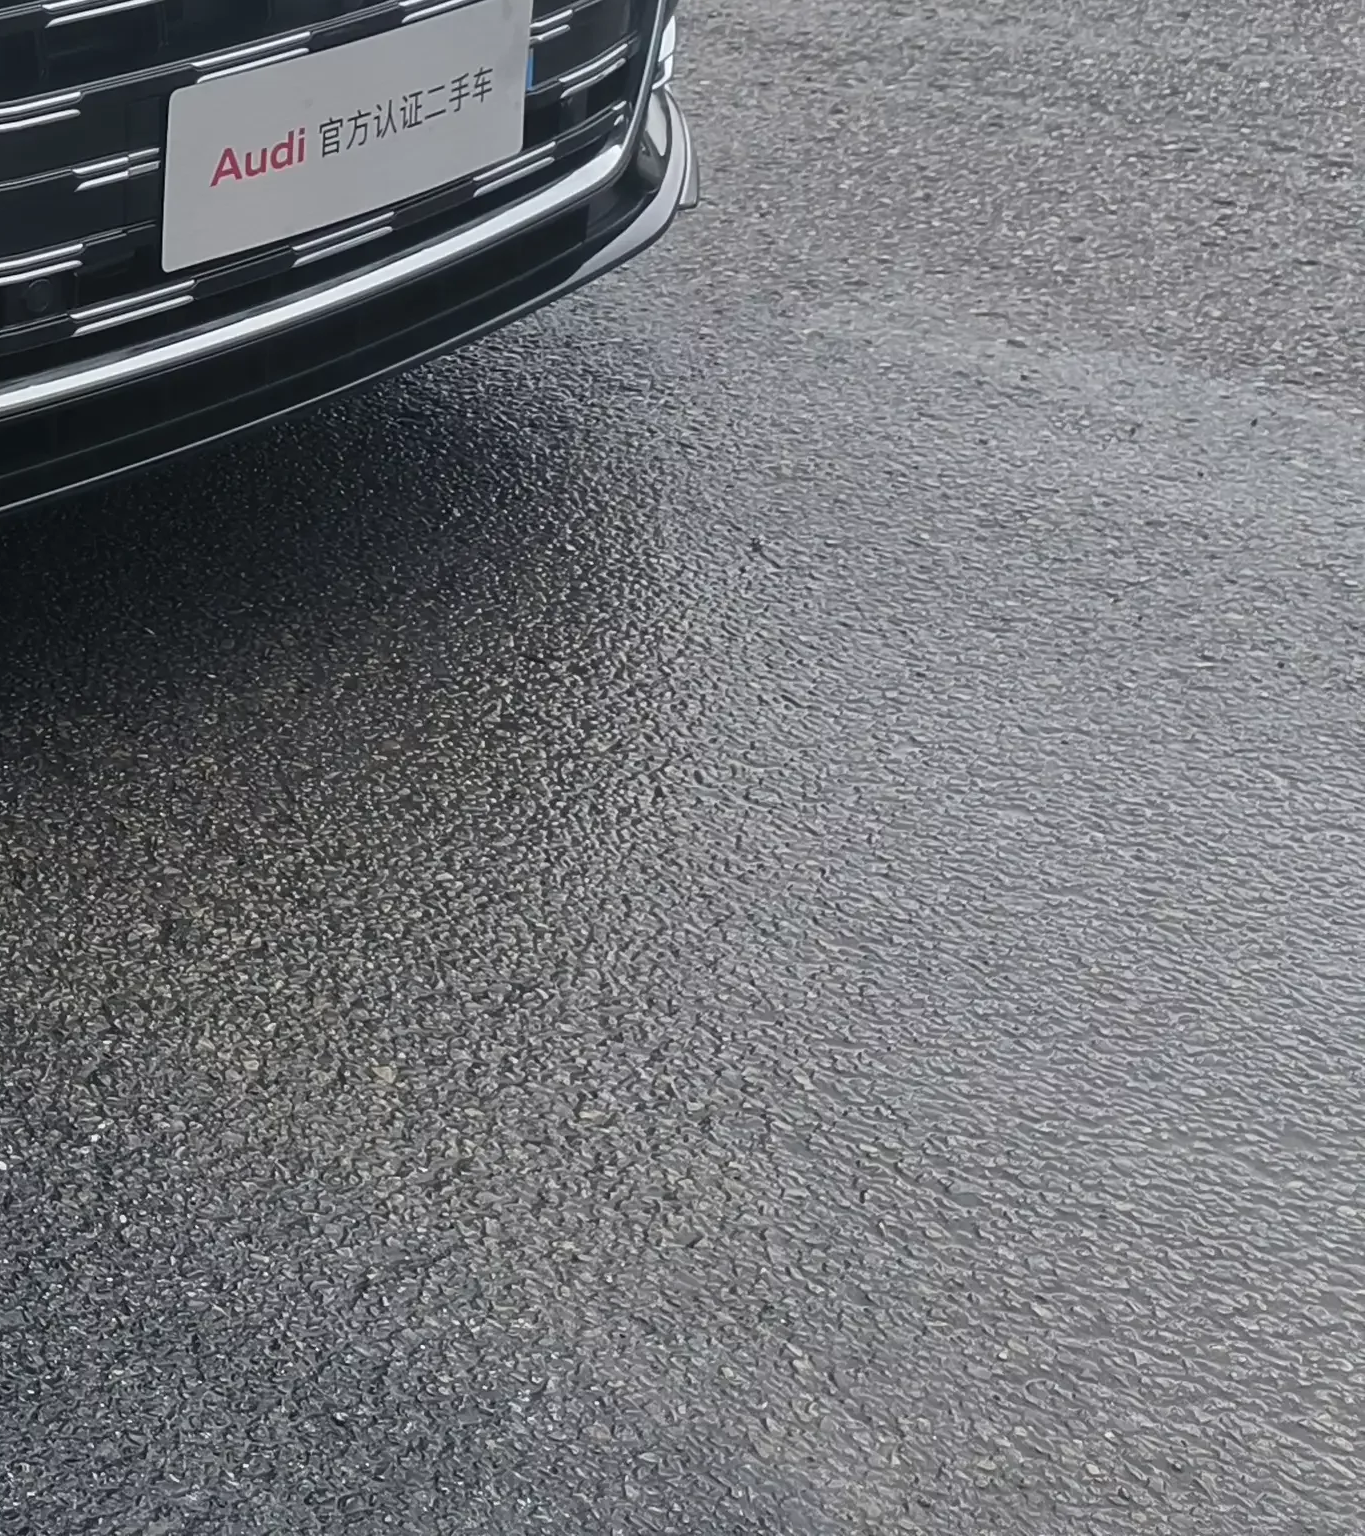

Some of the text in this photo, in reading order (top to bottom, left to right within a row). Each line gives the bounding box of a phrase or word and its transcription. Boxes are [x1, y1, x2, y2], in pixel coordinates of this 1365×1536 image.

[209, 66, 495, 188] Audi 官方认证二手车
